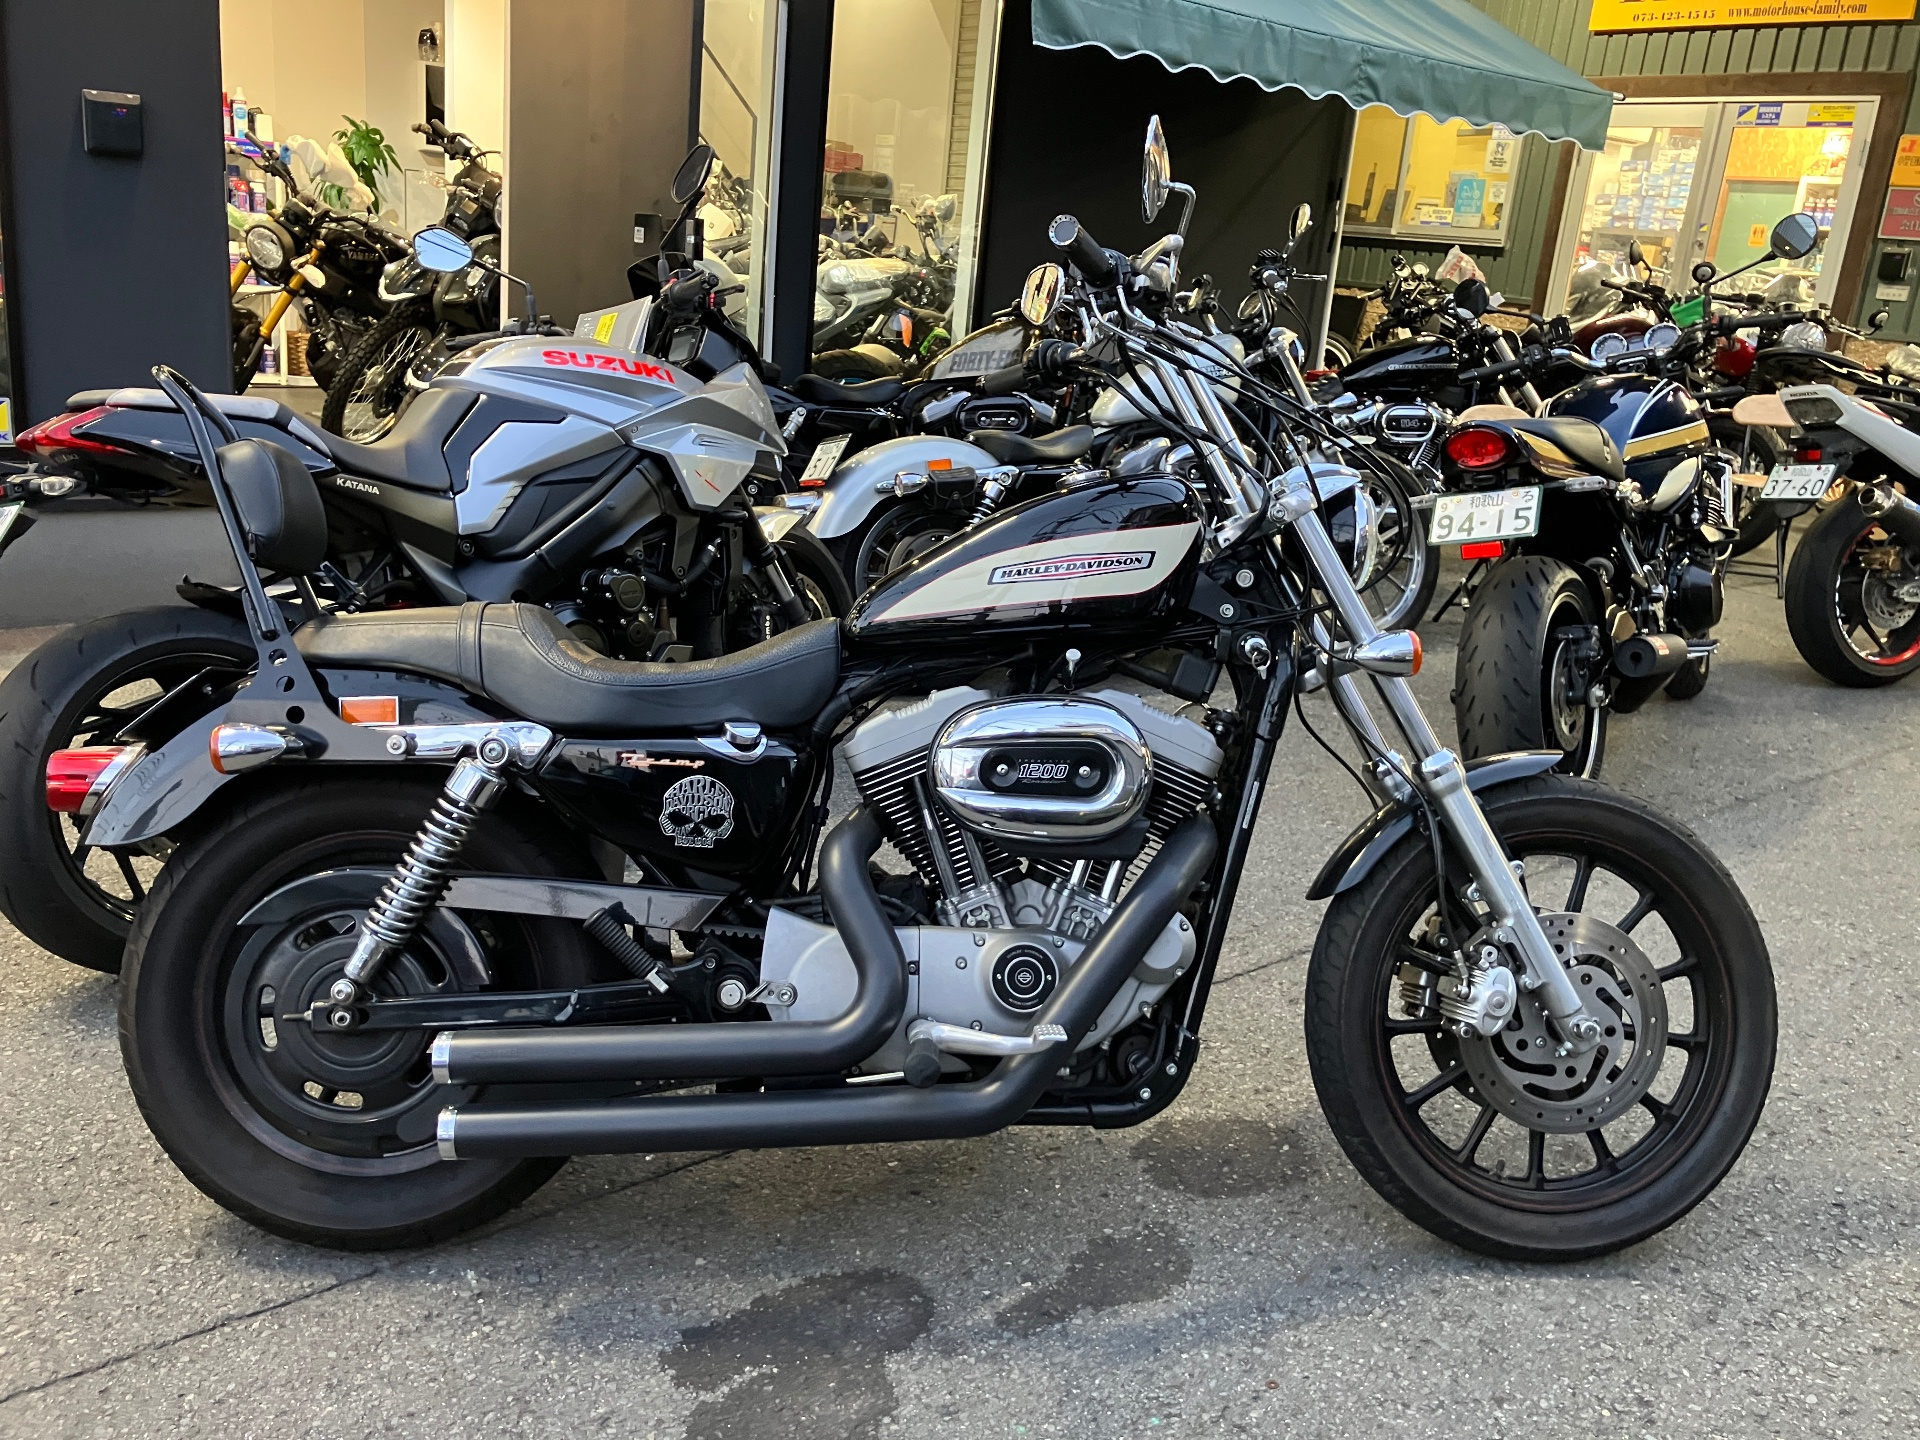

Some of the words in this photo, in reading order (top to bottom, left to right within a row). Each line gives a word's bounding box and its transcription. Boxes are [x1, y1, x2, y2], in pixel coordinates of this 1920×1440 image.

[541, 350, 676, 385] SUZUKI
[336, 477, 381, 496] KATANA
[1469, 494, 1504, 508] 和歌山
[1436, 507, 1532, 539] 94-15
[1000, 556, 1144, 579] HARLEY-DAVIDSON
[1018, 763, 1069, 779] 1200
[665, 793, 731, 811] DAVIDSON
